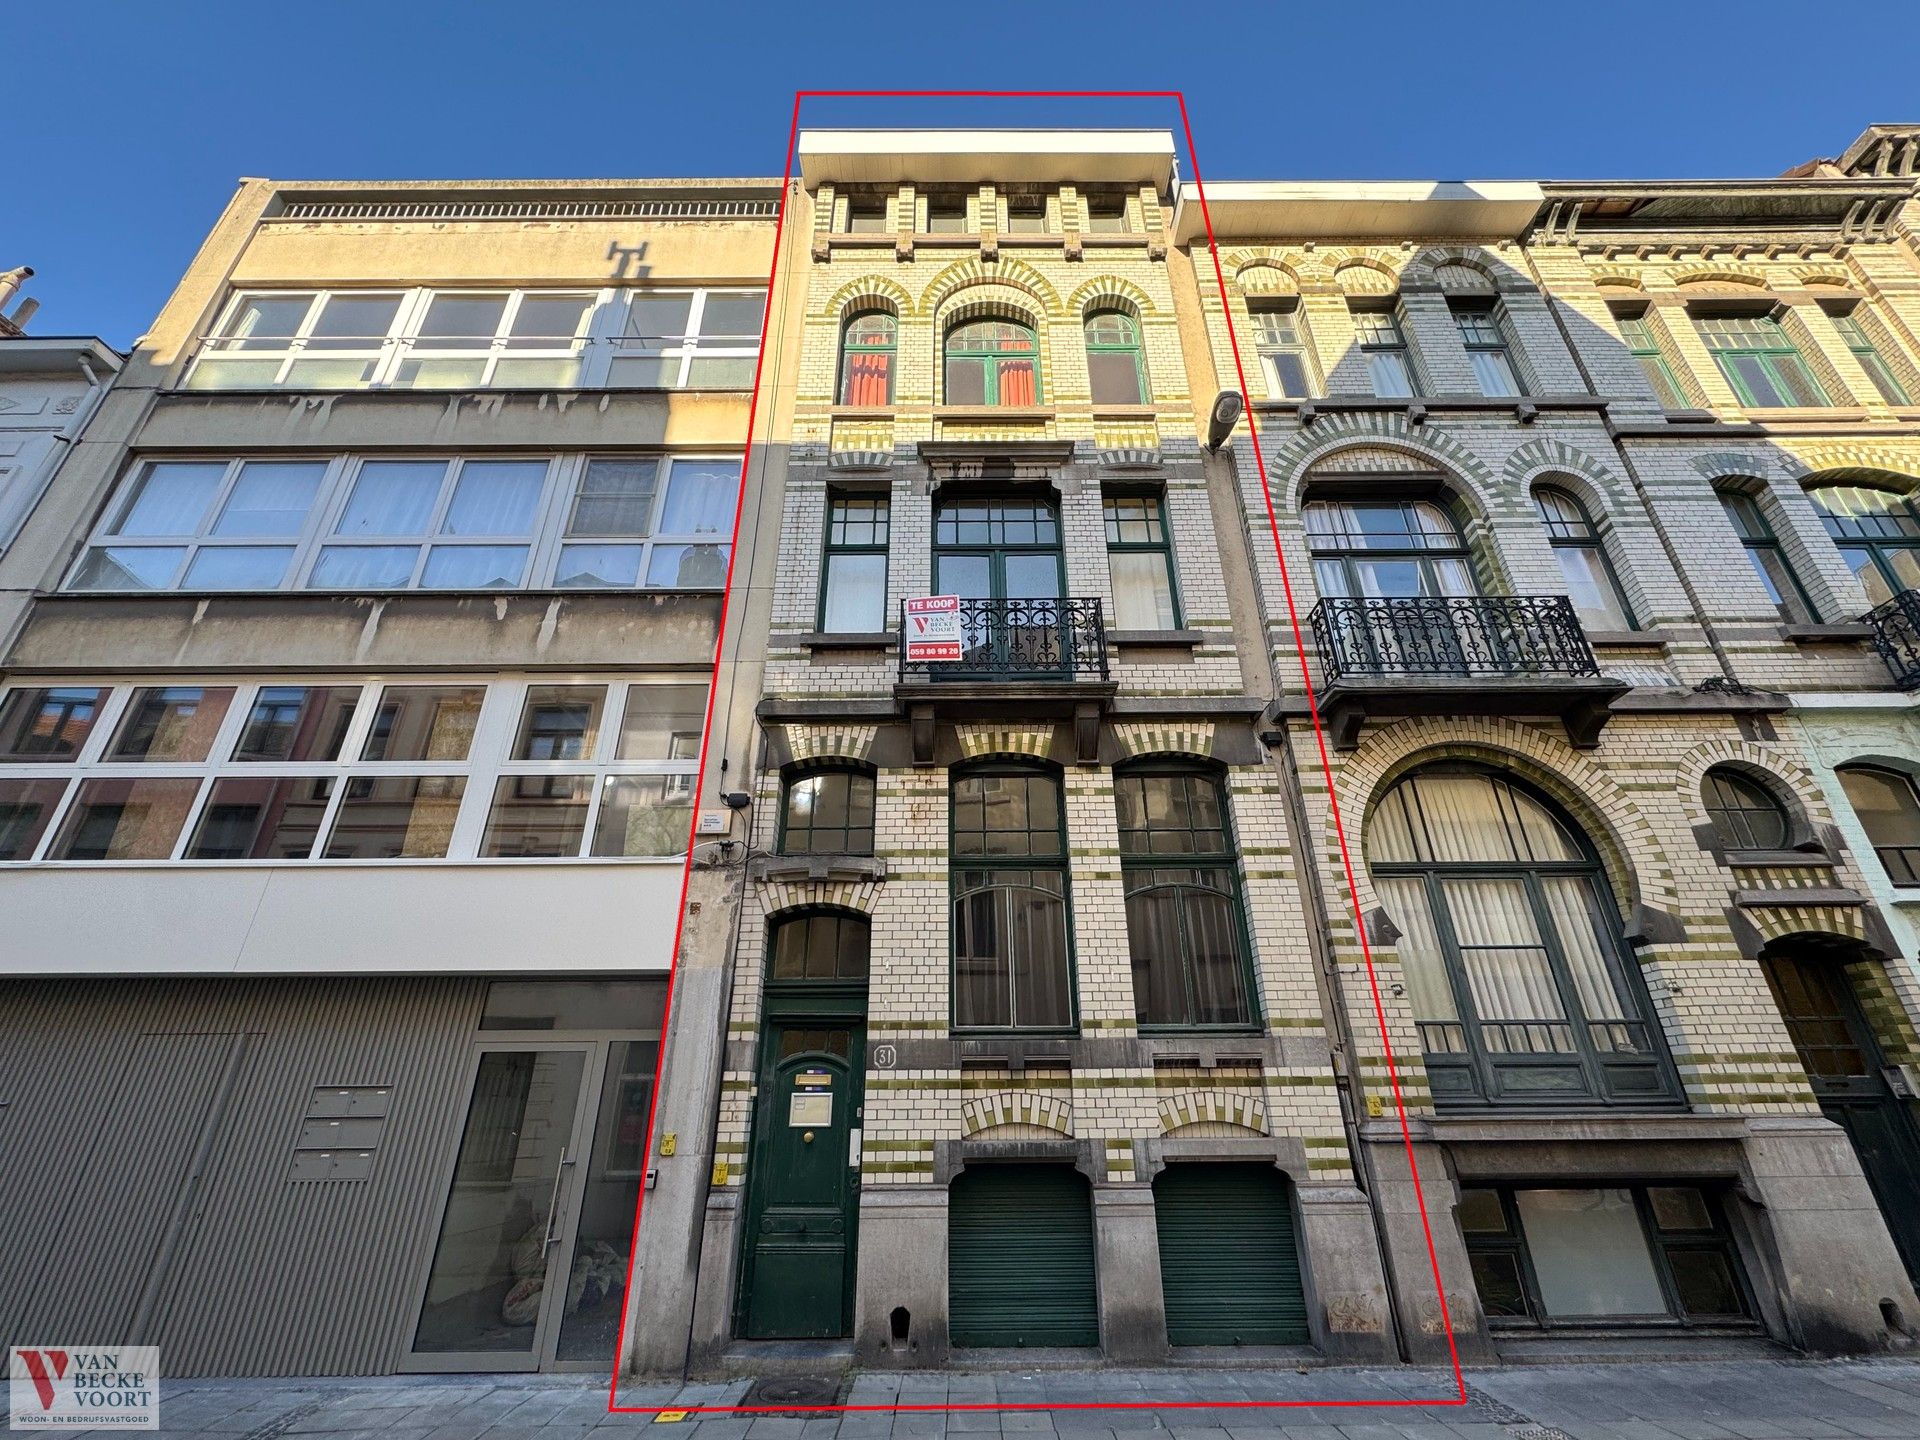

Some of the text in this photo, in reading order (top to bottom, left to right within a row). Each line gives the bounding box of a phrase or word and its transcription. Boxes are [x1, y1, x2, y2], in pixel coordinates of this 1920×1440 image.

[911, 599, 955, 610] TE KOOP
[879, 1049, 891, 1064] 31
